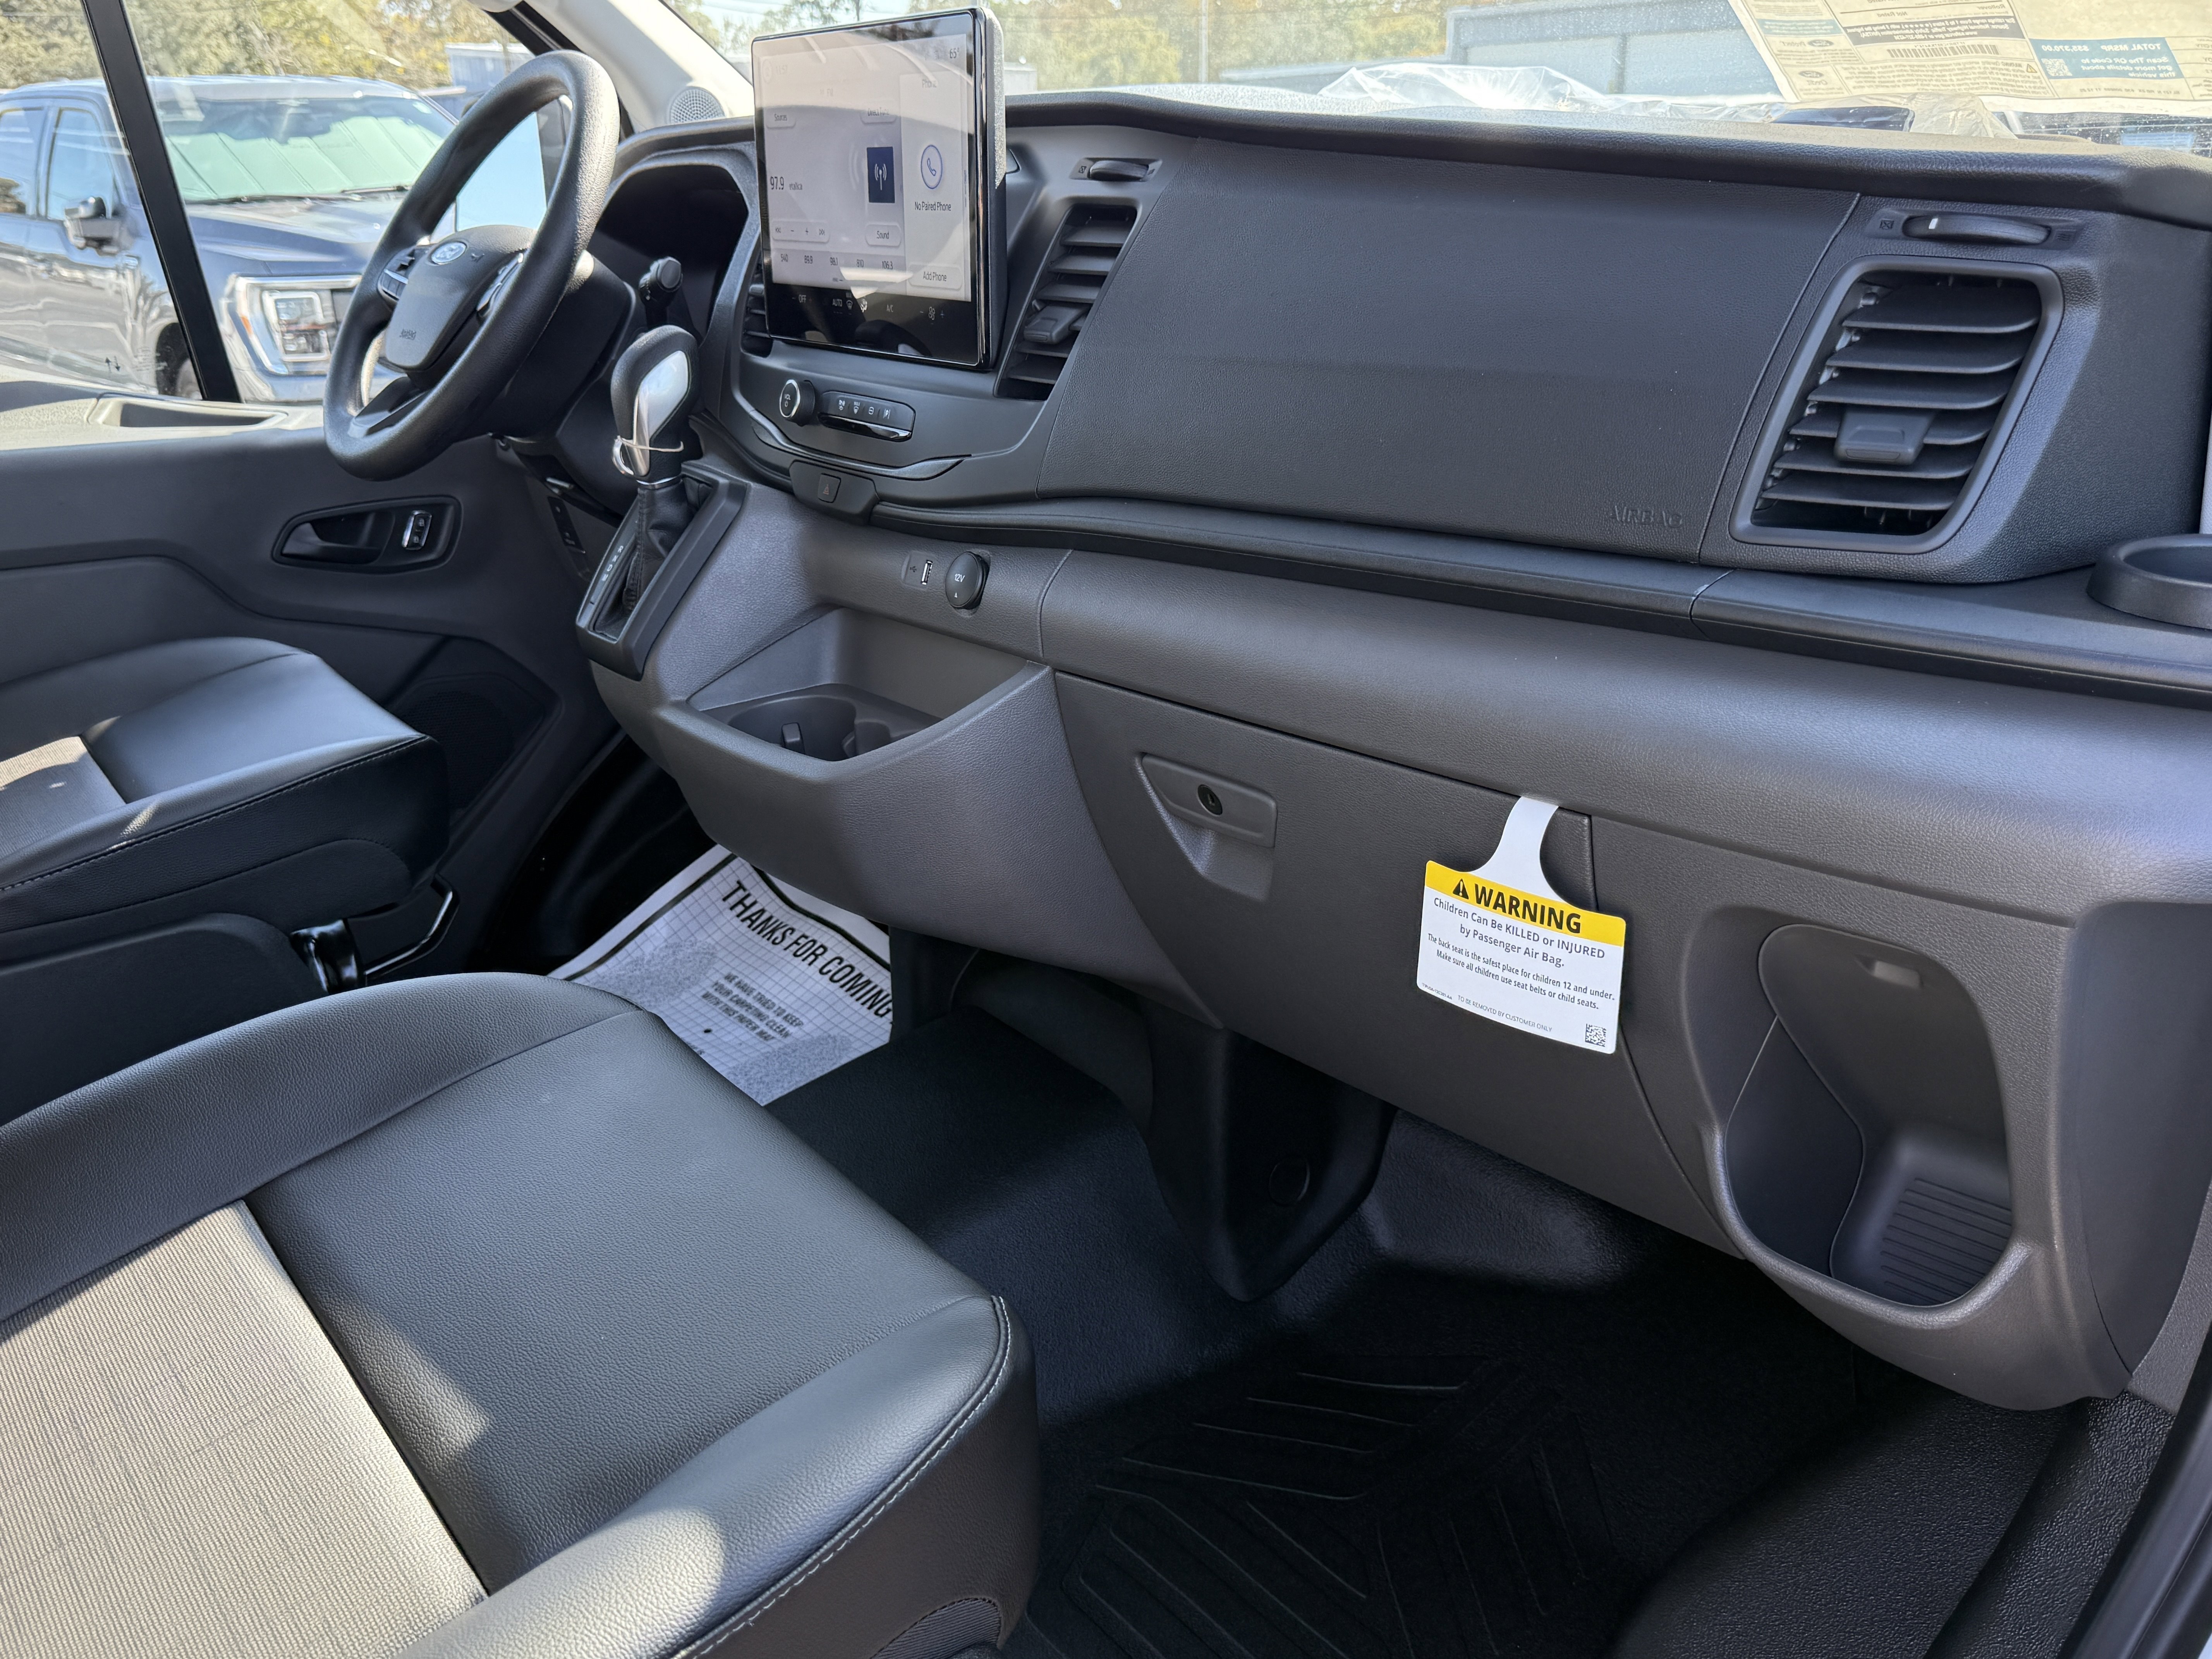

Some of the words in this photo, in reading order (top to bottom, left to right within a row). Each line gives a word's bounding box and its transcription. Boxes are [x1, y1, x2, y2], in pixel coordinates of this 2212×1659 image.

[774, 113, 788, 121] Sources
[770, 176, 784, 190] 97.9
[915, 201, 921, 211] No
[922, 201, 936, 211] Paired
[937, 201, 951, 211] Phone
[876, 230, 890, 239] Sound
[923, 271, 932, 280] Add
[933, 273, 947, 282] Phone
[799, 294, 807, 303] OFF
[832, 299, 843, 307] AUTO
[954, 573, 965, 583] 12V
[1474, 883, 1581, 934] WARNING
[1434, 897, 1468, 919] Children
[1471, 913, 1488, 926] Can
[1491, 920, 1503, 931] Be
[1505, 924, 1540, 942] KILLED
[1543, 937, 1554, 946] or
[1558, 939, 1605, 958] INJURED
[721, 879, 797, 946] THANKS
[783, 932, 829, 967] FOR
[818, 955, 893, 1018] COMING
[1460, 924, 1470, 938] by
[1473, 929, 1521, 953] Passenger
[1523, 947, 1539, 959] Air
[1542, 952, 1565, 968] Bag.
[1428, 933, 1437, 944] The
[1438, 938, 1451, 950] back
[1452, 945, 1463, 955] seat
[1465, 949, 1470, 957] is
[1471, 951, 1481, 962] the
[1482, 957, 1501, 969] safest
[1502, 964, 1519, 975] place
[1521, 968, 1530, 979] for
[1532, 972, 1561, 987] children
[1563, 981, 1571, 990] 12
[1573, 986, 1587, 994] and
[1590, 990, 1615, 1000] under.
[1436, 949, 1451, 962] Make
[1453, 958, 1465, 968] sure
[1475, 966, 1499, 981] children
[1501, 976, 1512, 985] use
[1513, 981, 1528, 991] seat
[1530, 984, 1546, 995] belts
[1558, 993, 1575, 1003] child
[1577, 998, 1599, 1009] seats.
[1472, 1001, 1497, 1015] REMOVED
[1505, 1013, 1536, 1027] CUSTOMER
[1537, 1023, 1553, 1032] ONLY
